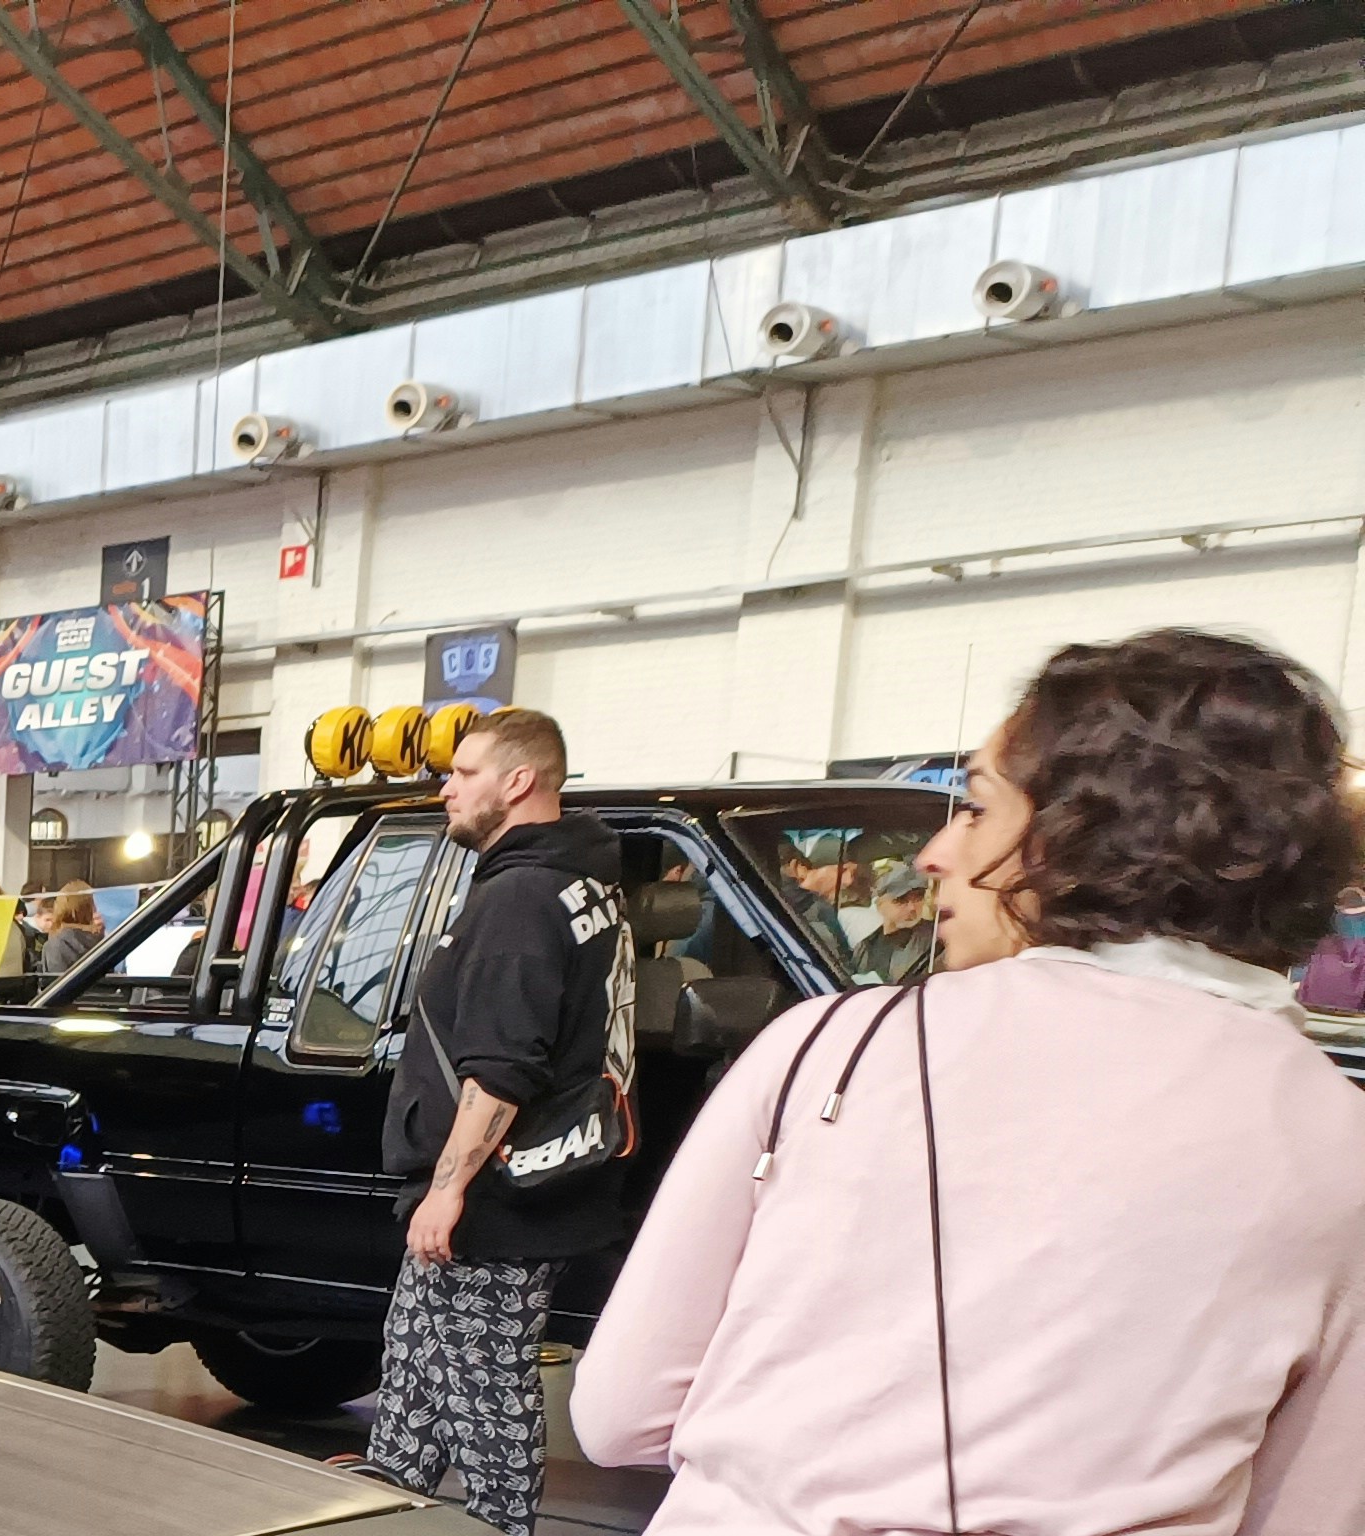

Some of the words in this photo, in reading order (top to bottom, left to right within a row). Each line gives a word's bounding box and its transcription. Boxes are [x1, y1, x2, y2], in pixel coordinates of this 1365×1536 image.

[1, 648, 150, 700] GUEST
[16, 693, 126, 731] ALLEY
[557, 879, 588, 914] IF
